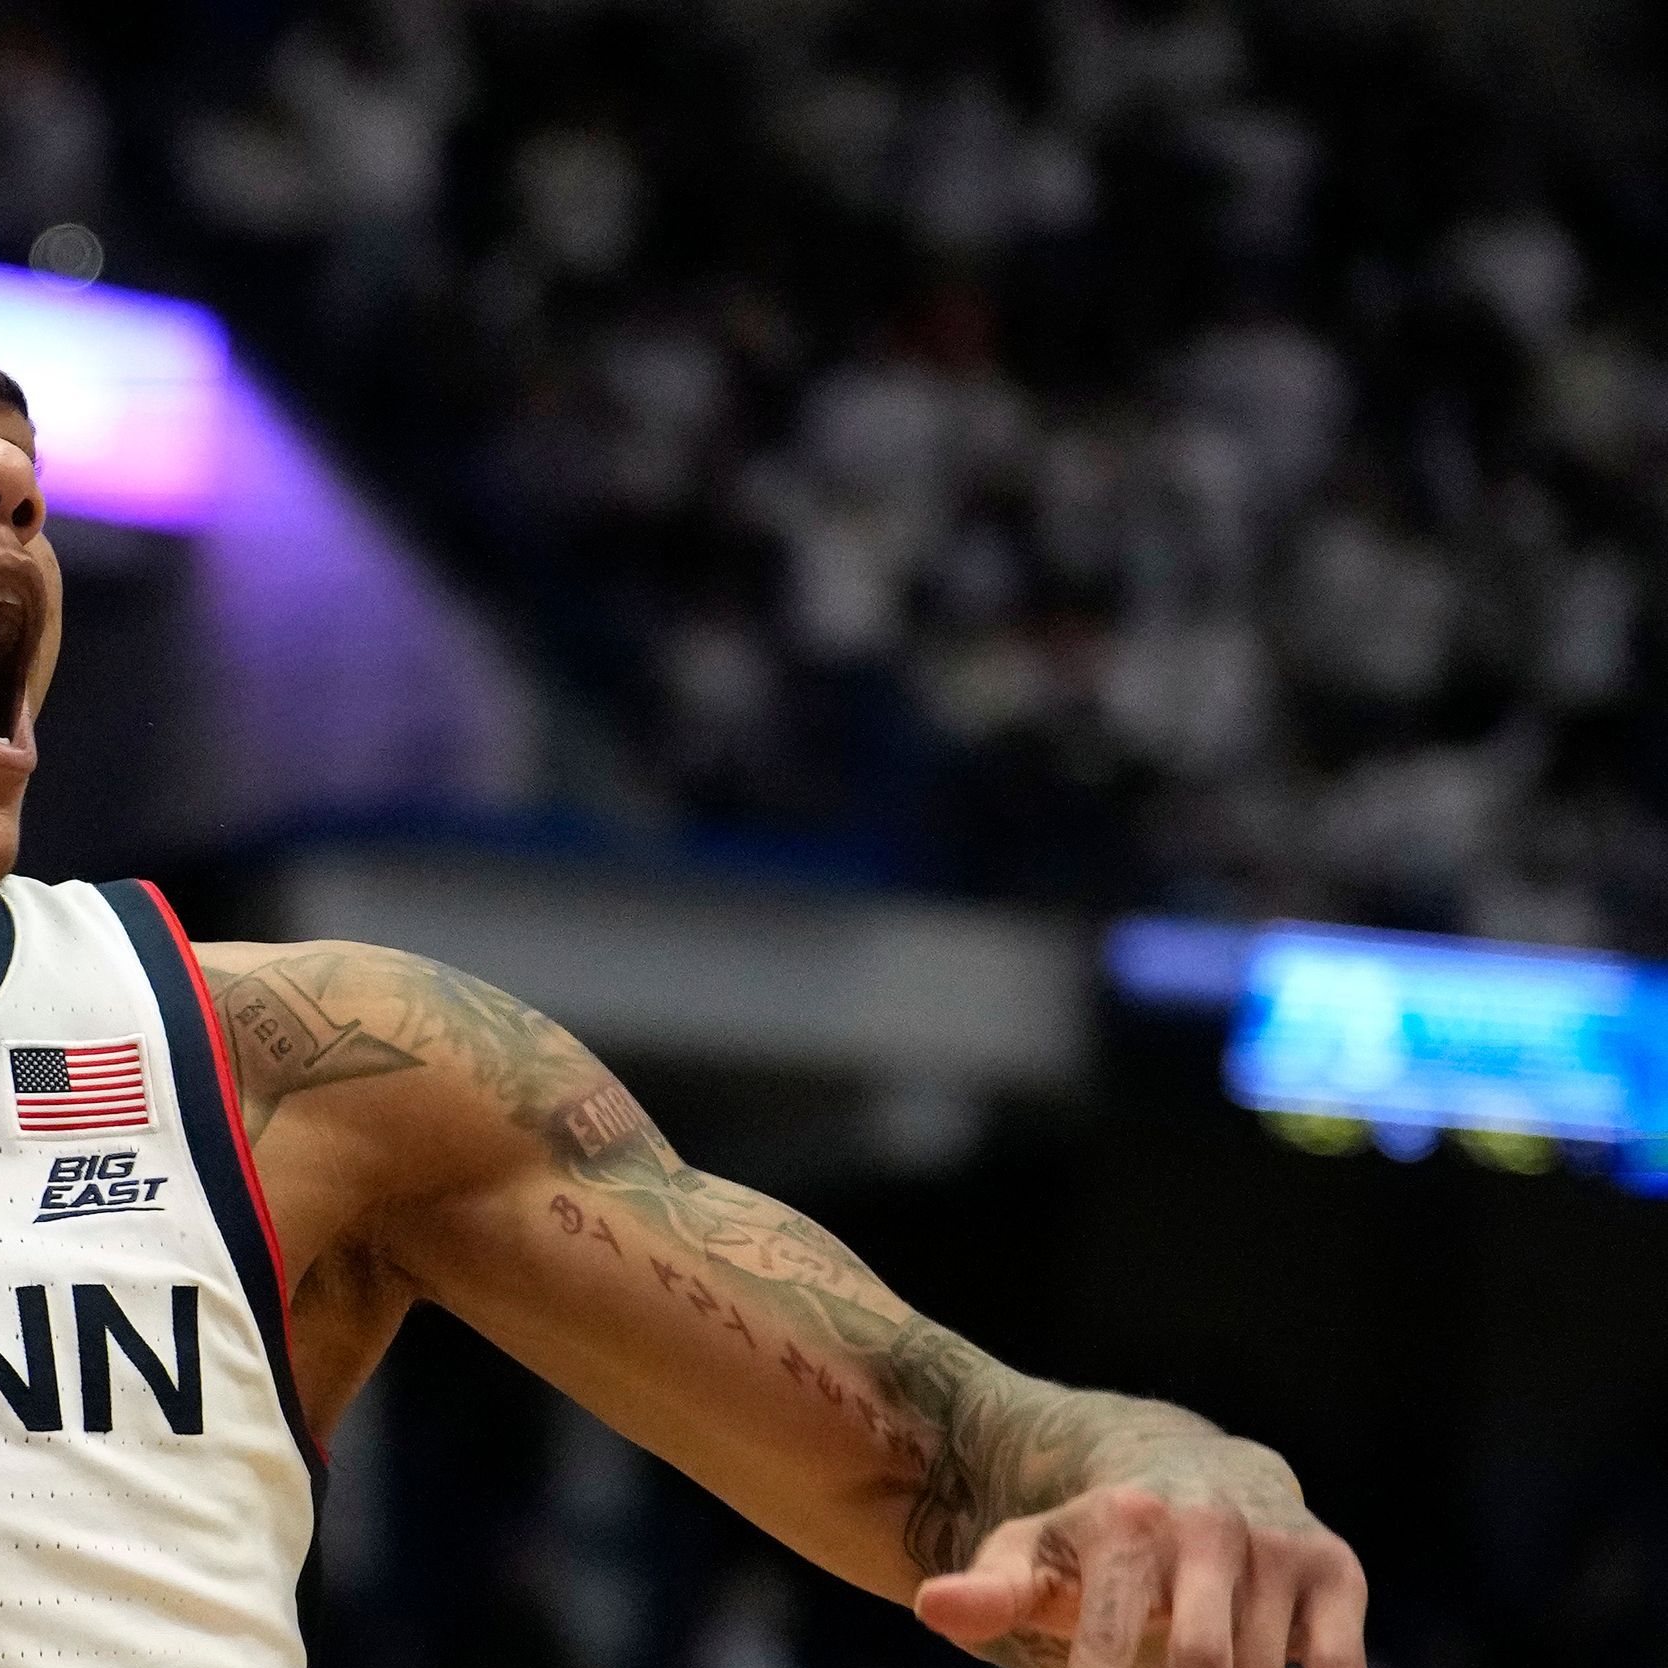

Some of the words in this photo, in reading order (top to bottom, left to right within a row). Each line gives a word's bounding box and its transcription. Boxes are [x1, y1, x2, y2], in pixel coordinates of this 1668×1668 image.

[48, 1152, 138, 1183] BIG
[40, 1177, 168, 1210] EAST
[550, 1194, 622, 1257] BY
[649, 1256, 757, 1350] ANY
